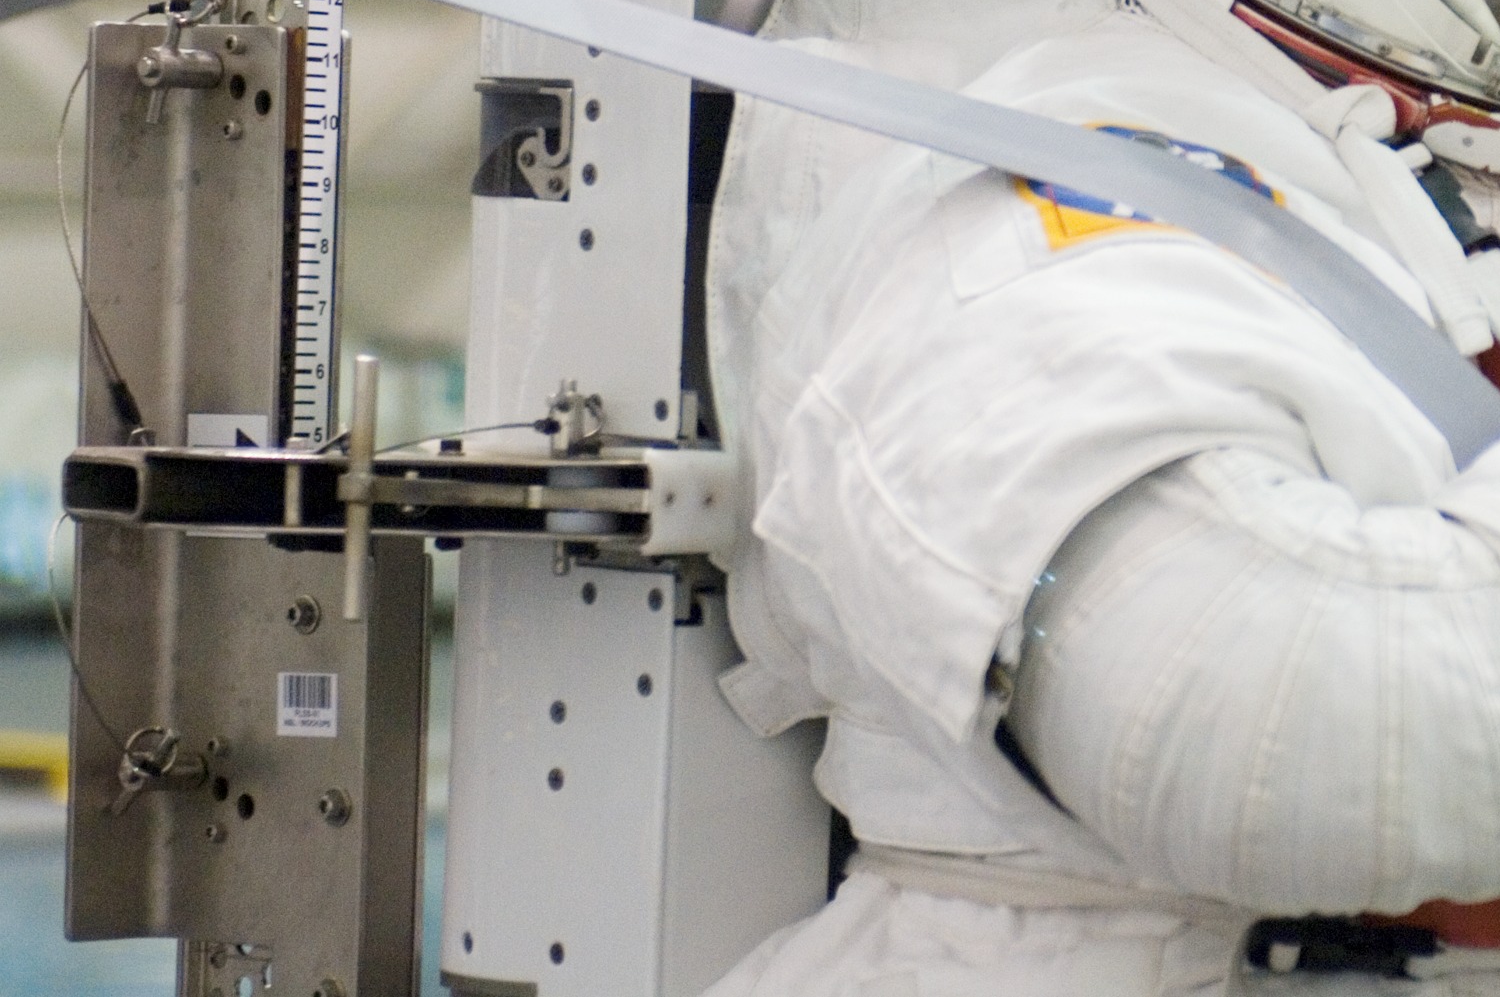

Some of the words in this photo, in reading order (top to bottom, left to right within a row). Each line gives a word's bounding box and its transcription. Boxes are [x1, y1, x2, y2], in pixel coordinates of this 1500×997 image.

[324, 53, 339, 68] 11
[322, 115, 338, 130] 10
[323, 178, 331, 192] 9
[320, 239, 328, 254] 8
[318, 301, 326, 315] 7
[316, 365, 324, 379] 6
[314, 428, 322, 442] 5
